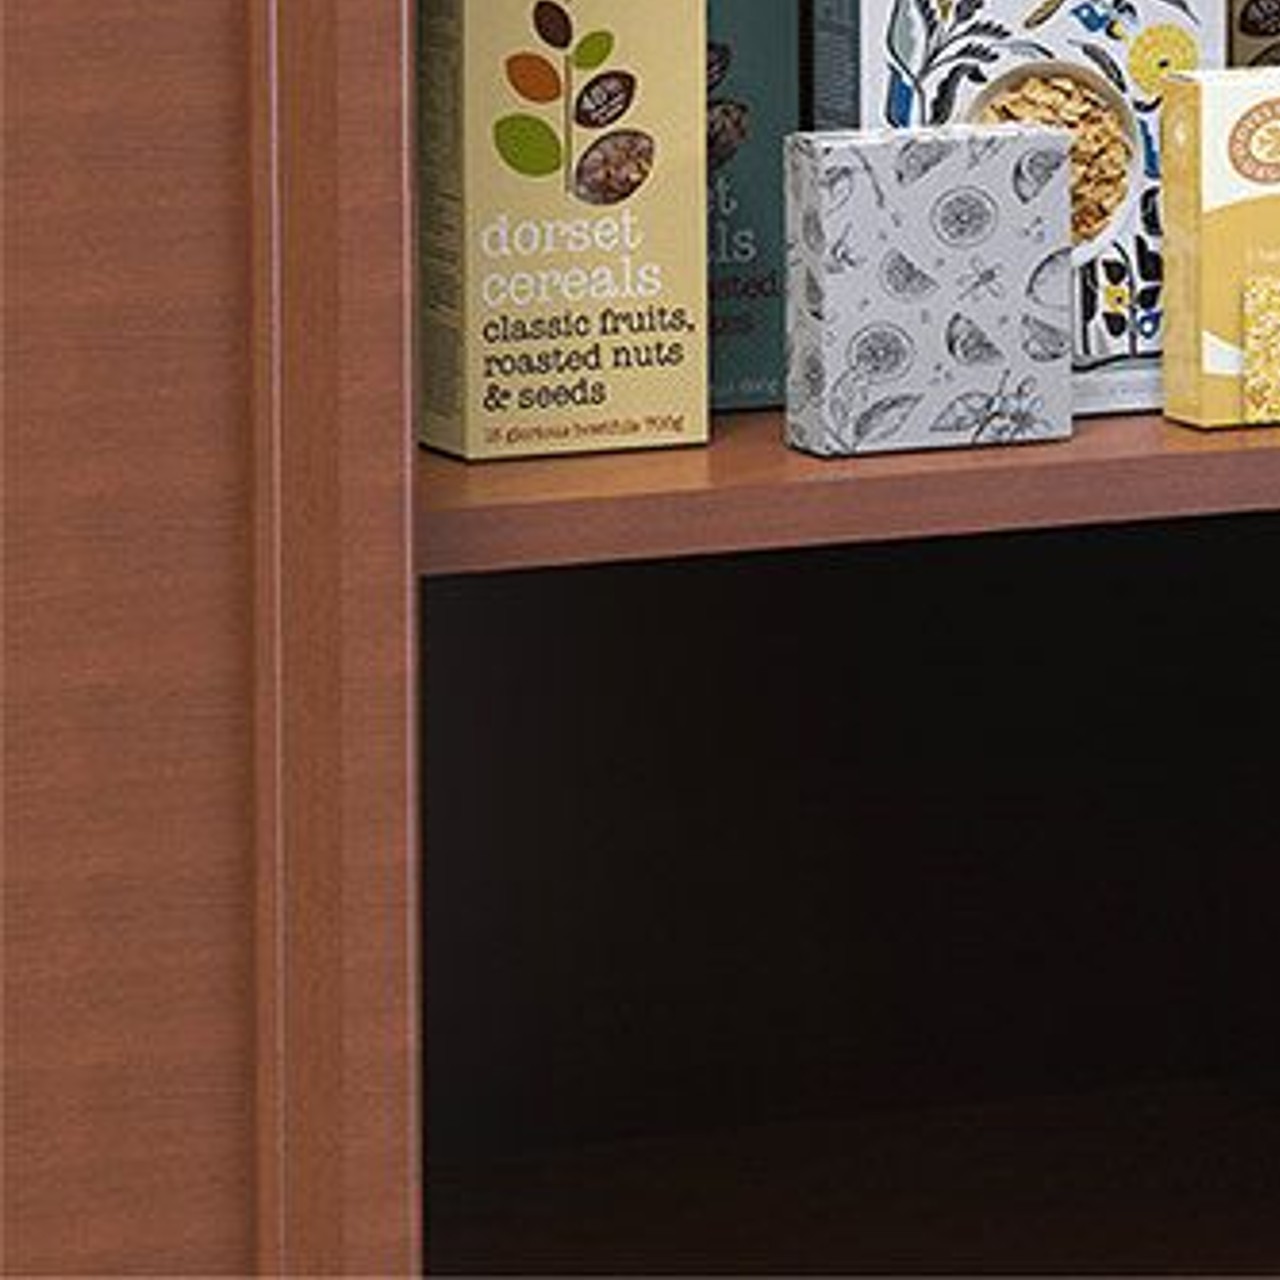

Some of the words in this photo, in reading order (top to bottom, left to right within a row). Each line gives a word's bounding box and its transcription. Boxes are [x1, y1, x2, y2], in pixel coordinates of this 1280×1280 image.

[481, 207, 643, 260] dorset
[482, 257, 664, 308] cereals
[482, 310, 592, 344] classic
[482, 344, 602, 380] roasted
[611, 340, 685, 369] nuts
[481, 384, 513, 413] &
[517, 378, 608, 411] seeds
